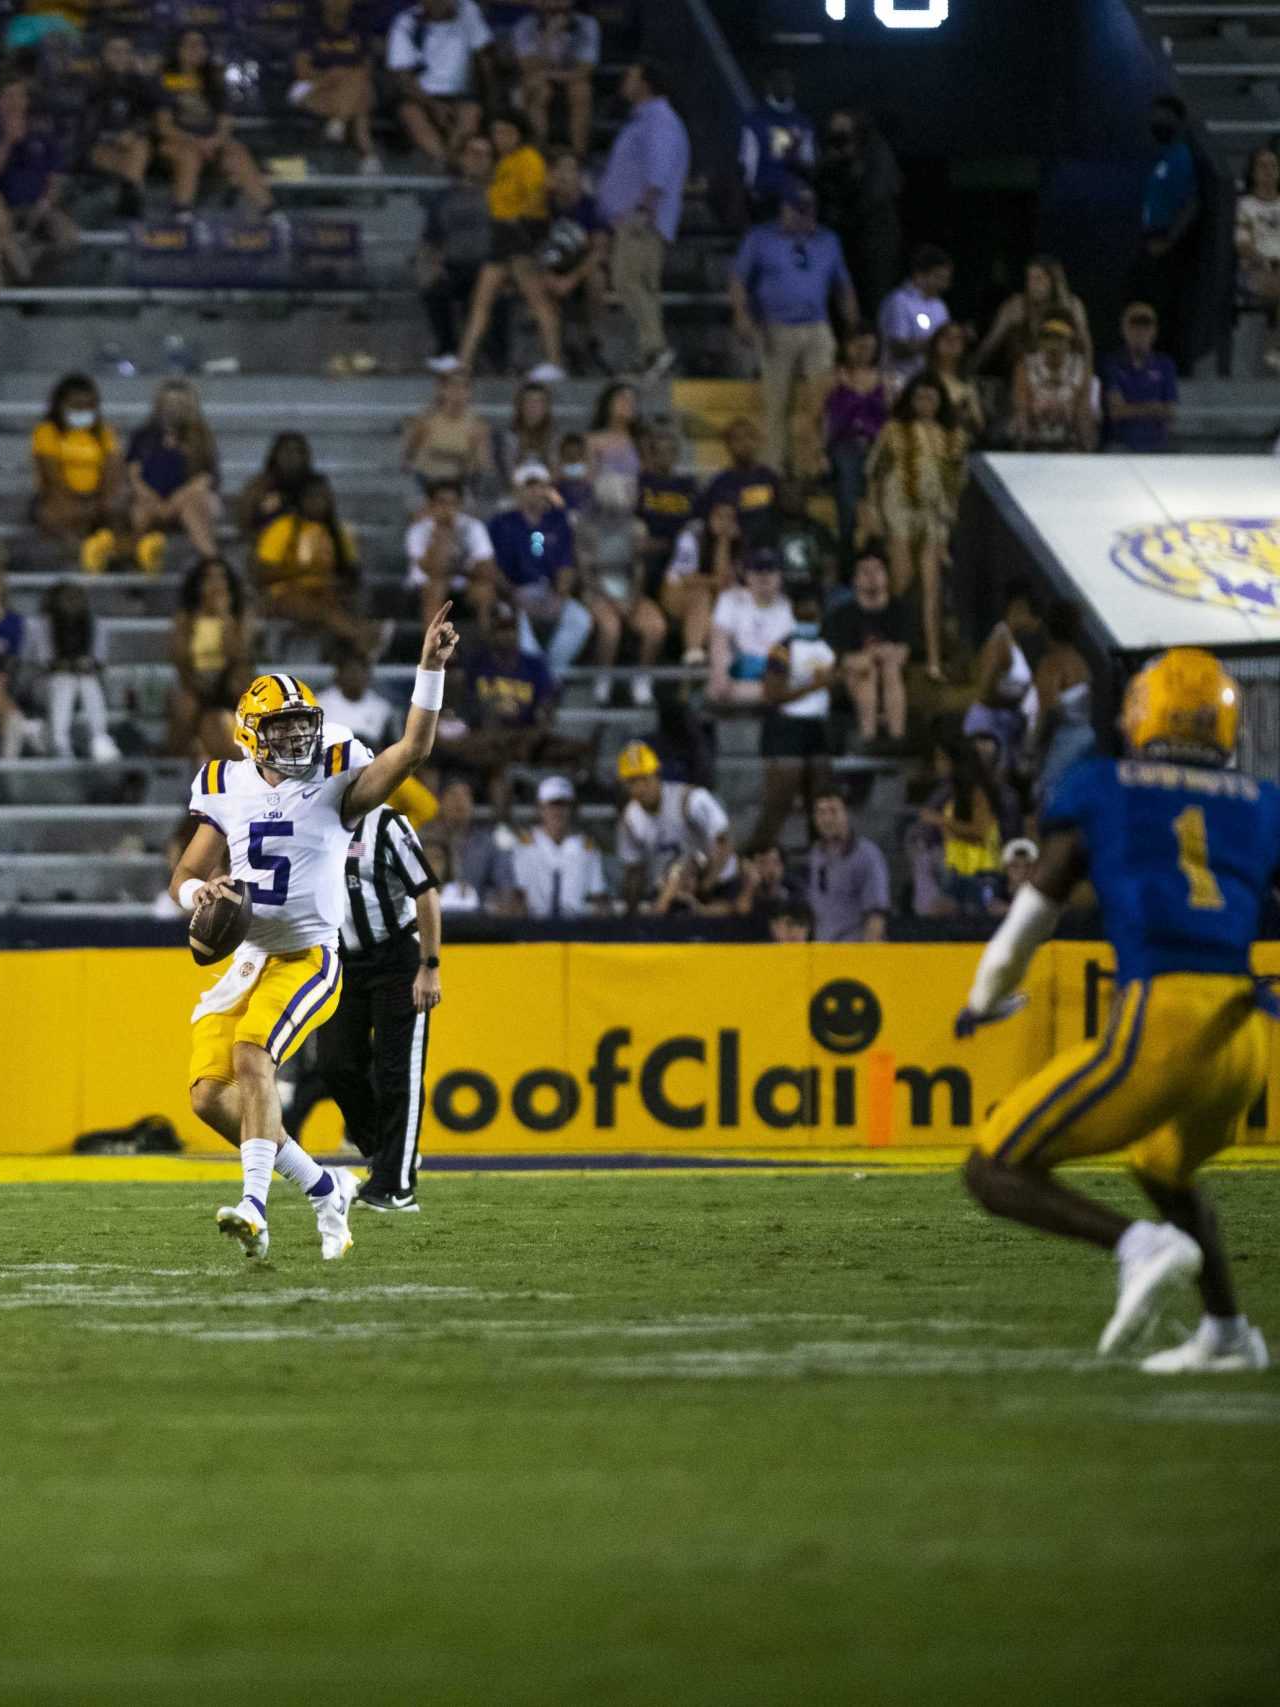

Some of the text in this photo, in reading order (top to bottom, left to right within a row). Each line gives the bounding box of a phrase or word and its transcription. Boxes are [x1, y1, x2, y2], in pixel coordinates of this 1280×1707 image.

[263, 810, 283, 820] LSU
[1173, 804, 1225, 910] 1
[247, 820, 294, 907] 5
[431, 982, 994, 1132] oofClaim
